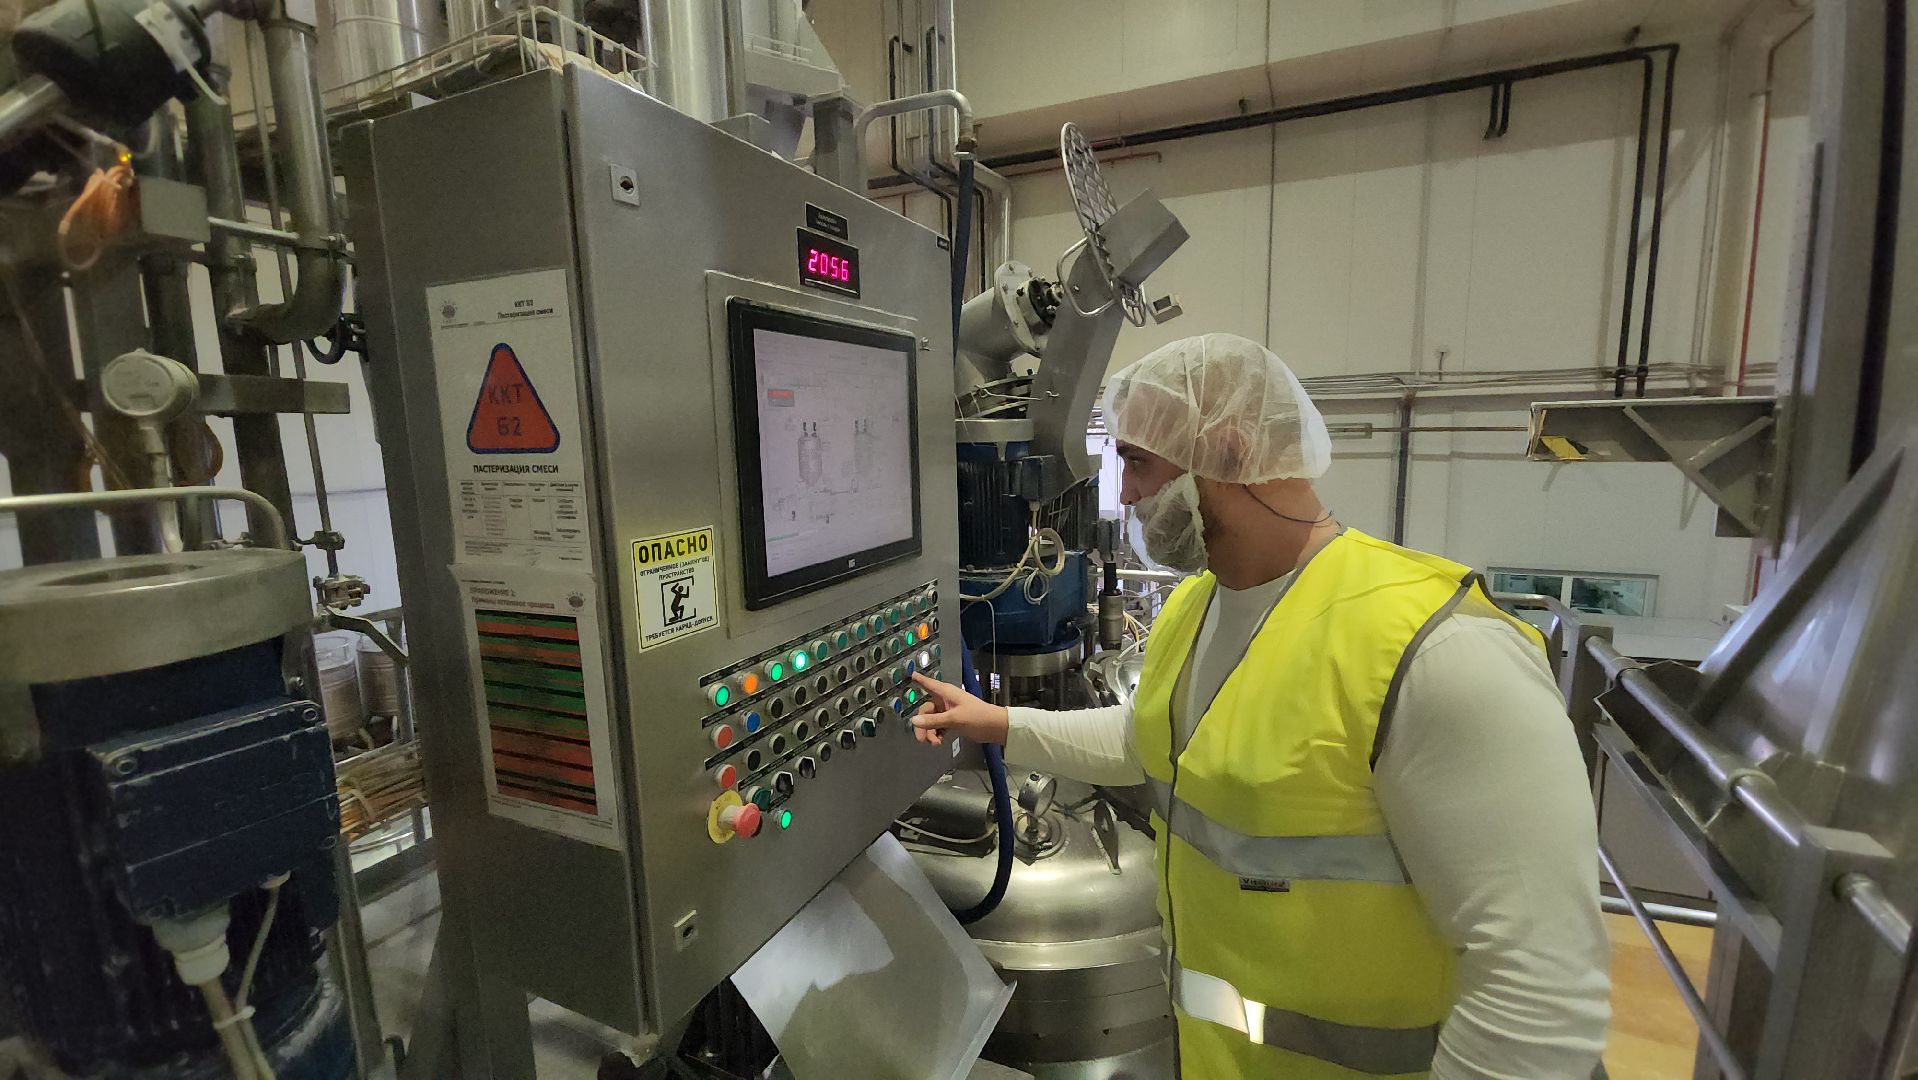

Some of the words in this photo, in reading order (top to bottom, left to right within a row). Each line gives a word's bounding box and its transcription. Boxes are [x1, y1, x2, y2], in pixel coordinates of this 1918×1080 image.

[808, 248, 850, 282] 2056
[488, 383, 524, 405] ККТ
[473, 464, 530, 475] ПАСТЕРИЗАЦИЯ
[532, 464, 559, 474] СМЕСИ
[638, 533, 708, 564] ОПАСНО
[639, 562, 679, 577] ОГРАНИЧЕННОЕ
[658, 567, 695, 581] ПРОСТРАНСТВО
[645, 627, 675, 642] ТРЕБУЕТСЯ
[675, 615, 713, 634] НАРЯД-ДОПУСК
